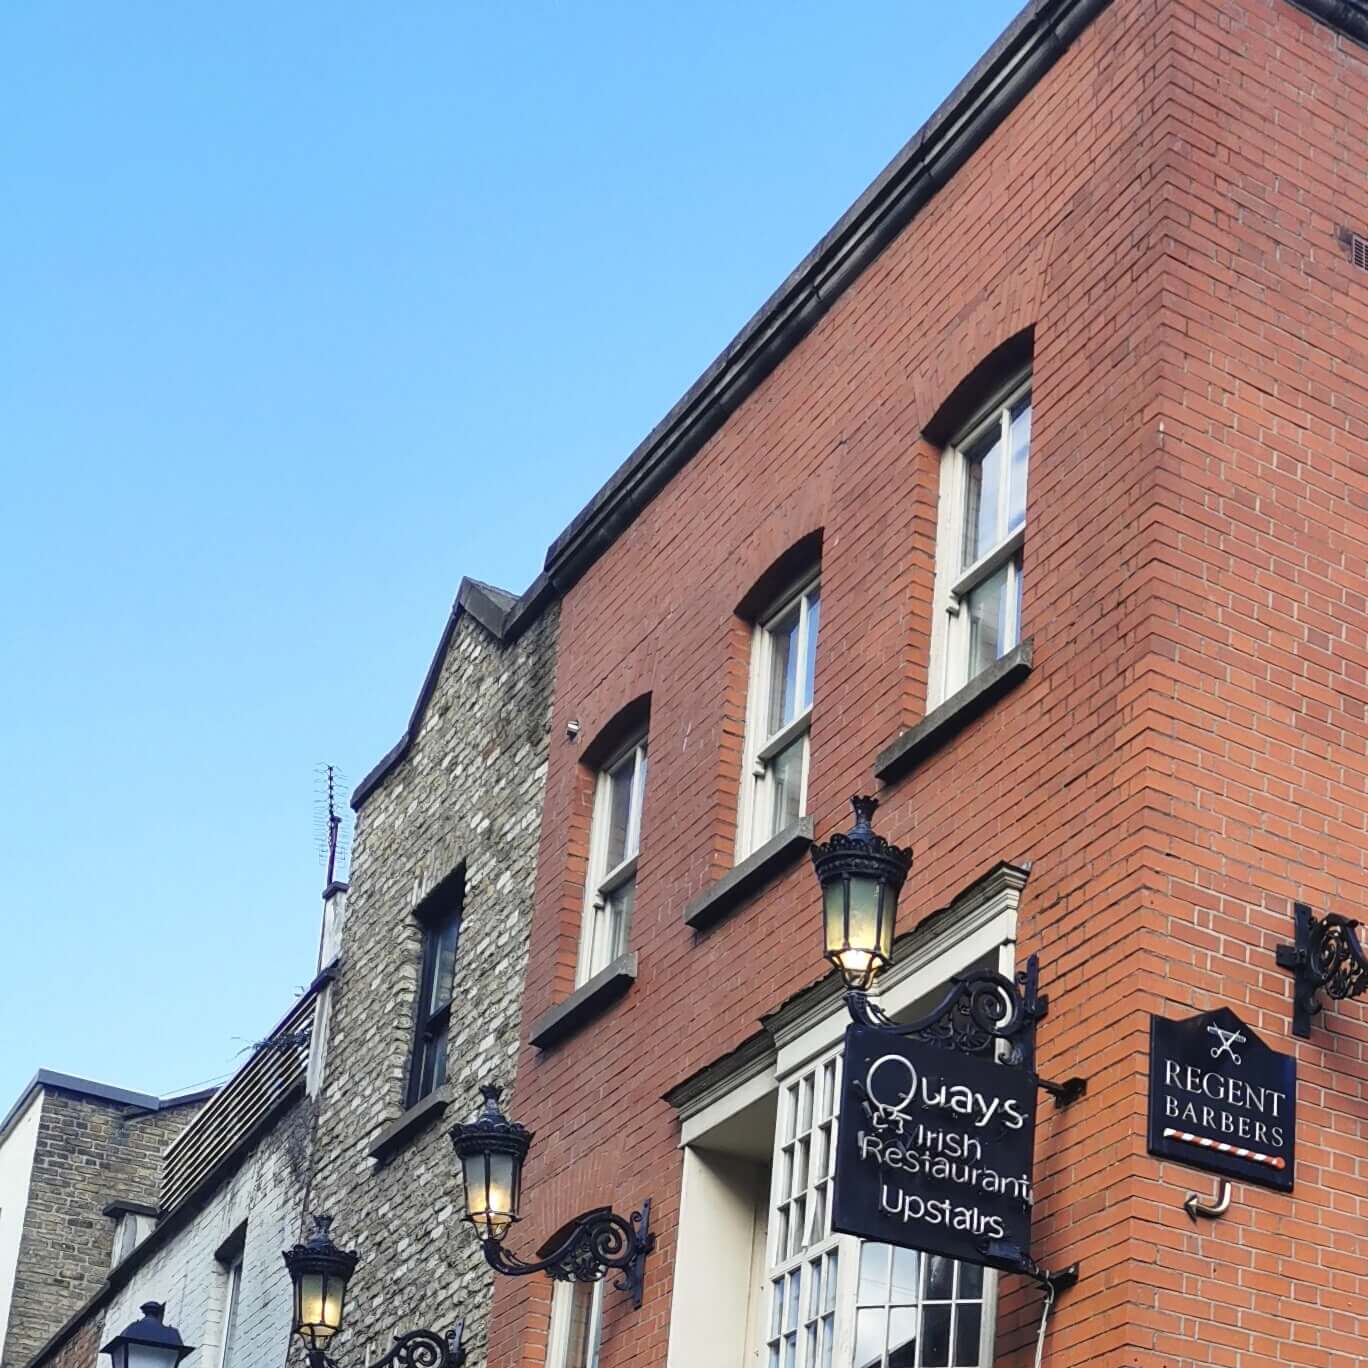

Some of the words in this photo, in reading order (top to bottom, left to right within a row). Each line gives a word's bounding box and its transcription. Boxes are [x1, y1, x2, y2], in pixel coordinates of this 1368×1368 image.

[866, 1054, 1025, 1129] Quays
[1165, 1059, 1286, 1117] REGENT
[917, 1124, 982, 1160] Irish
[1165, 1095, 1284, 1147] BARBERS
[861, 1135, 1032, 1202] Restaurant
[882, 1184, 1005, 1239] Upstairs
